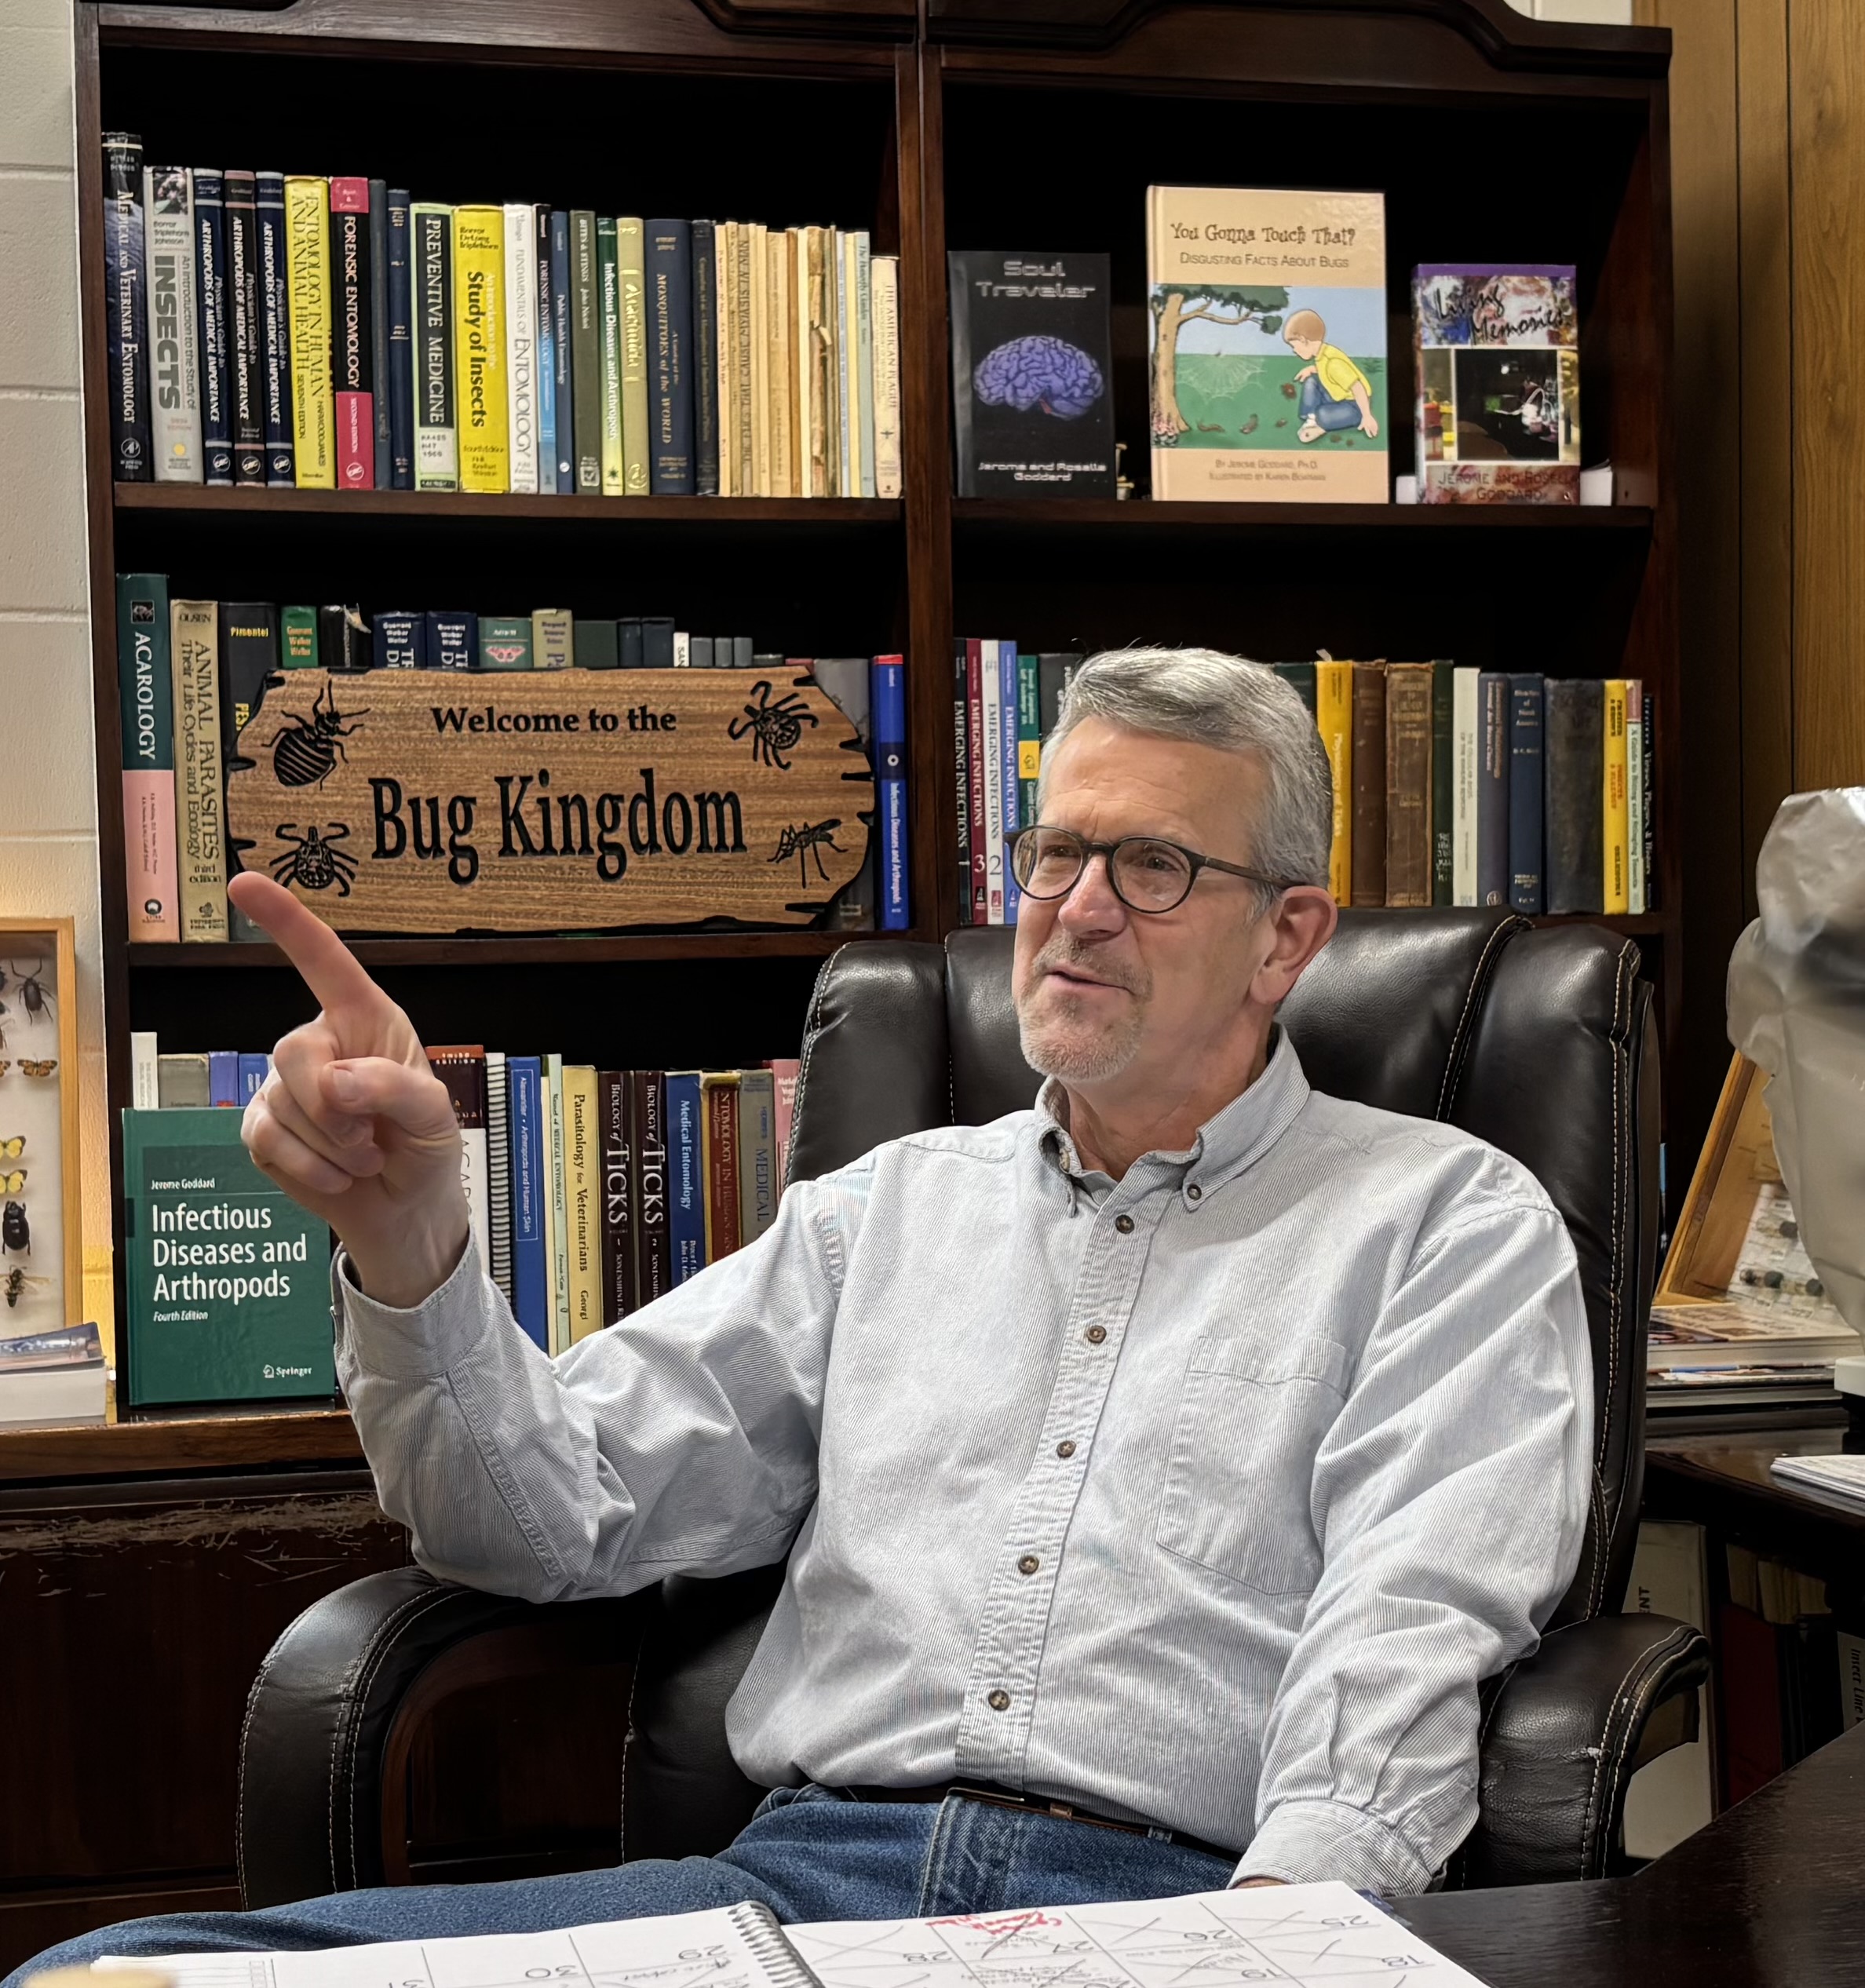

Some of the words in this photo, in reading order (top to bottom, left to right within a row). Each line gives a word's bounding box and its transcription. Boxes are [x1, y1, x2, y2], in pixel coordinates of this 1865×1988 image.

[117, 191, 136, 246] MEDICAL
[292, 197, 307, 232] AND
[1170, 223, 1199, 240] You
[1204, 224, 1256, 245] Gonna
[1262, 225, 1306, 244] Touch
[1311, 225, 1356, 246] That?
[182, 256, 192, 268] An
[203, 219, 214, 291] ARTHROPODS
[233, 216, 245, 288] ARTHROPODS
[264, 221, 276, 294] ARTHROPODS
[293, 237, 309, 303] ANIMAL
[305, 197, 321, 305] ENTOMOLOGY
[344, 216, 360, 283] FORENSIC
[1003, 261, 1067, 278] Soul
[1180, 252, 1242, 267] DISGUSTING
[1244, 254, 1278, 267] FACTS
[1281, 255, 1316, 268] ABOUT
[1319, 256, 1349, 268] BUGS
[425, 219, 443, 328] PREVENTIVE
[514, 250, 528, 319] FUNDAMENTALS
[540, 261, 550, 303] FORENSIC
[604, 263, 616, 313] Infectious
[975, 282, 1096, 298] Traveler
[119, 270, 137, 341] VETERINARY
[183, 271, 194, 333] Introduction
[205, 291, 215, 308] OF
[235, 289, 246, 305] OF
[266, 294, 276, 310] OF
[464, 272, 487, 329] Study
[656, 273, 669, 357] MOSQUITOES
[155, 256, 181, 410] INSECTS
[184, 336, 193, 348] to
[206, 308, 217, 354] MEDICAL
[236, 305, 247, 351] MEDICAL
[267, 310, 279, 356] MEDICAL
[295, 307, 312, 370] HEALTH
[309, 312, 323, 330] IN
[346, 286, 361, 388] ENTOMOLOGY
[469, 332, 487, 353] of
[517, 320, 528, 335] OF
[605, 315, 618, 359] Diseases
[885, 308, 897, 367] AMERICAN
[185, 350, 195, 366] the
[309, 335, 326, 397] HUMAN
[428, 337, 446, 424] MEDICINE
[607, 360, 618, 380] and
[659, 359, 670, 371] of
[122, 341, 140, 424] ENTOMOLOGY
[186, 368, 197, 398] Study
[188, 398, 197, 410] of
[208, 356, 220, 424] IMPORTANCE
[238, 352, 250, 421] IMPORTANCE
[269, 358, 281, 425] IMPORTANCE
[470, 357, 487, 428] Insects
[514, 339, 533, 458] ENTOMOLOGY
[659, 375, 670, 392] the
[606, 381, 620, 440] Arthropods
[660, 397, 672, 444] WORLD
[978, 462, 1027, 472] Jerome
[1029, 462, 1054, 472] and
[1013, 472, 1072, 482] Goddard
[1438, 471, 1490, 485] JEROME
[229, 626, 269, 638] Pimentel
[181, 640, 195, 677] Their
[133, 631, 156, 761] ACAROLOGY
[182, 684, 196, 711] Life
[195, 641, 214, 731] ANIMAL
[181, 715, 199, 761] Cycles
[429, 705, 581, 736] Welcome
[587, 709, 620, 735] to
[627, 705, 679, 735] the
[953, 701, 965, 768] EMERGING
[970, 699, 981, 759] EMERGING
[987, 703, 998, 767] EMERGING
[1004, 706, 1015, 763] EMERGING
[186, 766, 199, 795] and
[199, 740, 220, 859] PARASITES
[890, 782, 902, 818] Infectious
[972, 761, 984, 827] INFECTIONS
[1005, 766, 1017, 829] INFECTIONS
[367, 775, 477, 886] Bug
[494, 768, 750, 885] Kingdom
[955, 771, 968, 848] INFECTIONS
[989, 771, 1000, 839] INFECTIONS
[187, 801, 202, 859] Ecology
[194, 864, 216, 874] third
[973, 854, 986, 874] 3
[989, 855, 1002, 876] 2
[610, 1083, 622, 1130] BIOLOGY
[646, 1085, 657, 1131] BIOLOGY
[680, 1100, 693, 1144] Medical
[573, 1094, 587, 1169] Parasitology
[610, 1131, 622, 1143] of
[646, 1132, 658, 1144] of
[151, 1178, 180, 1190] Jerome
[181, 1176, 216, 1190] Goddard
[606, 1143, 630, 1224] TICKS
[642, 1144, 666, 1225] TICKS
[680, 1146, 695, 1211] Entomology
[723, 1168, 732, 1182] IN
[756, 1148, 770, 1222] MEDICAL
[151, 1202, 272, 1232] Infectious
[577, 1188, 590, 1272] Veterinarians
[152, 1237, 255, 1268] Diseases
[262, 1233, 307, 1263] and
[152, 1268, 291, 1305] Arthropods
[579, 1289, 590, 1321] Georgi
[153, 1310, 180, 1322] Fourth
[181, 1309, 209, 1321] Edition
[276, 1365, 312, 1377] Springer
[1183, 1928, 1234, 1943] 26
[1320, 1914, 1370, 1929] 25
[524, 1962, 577, 1979] 30
[677, 1944, 727, 1961] 29
[903, 1950, 952, 1963] 28
[1053, 1940, 1095, 1955] 27
[1381, 1953, 1425, 1968] 18
[1240, 1967, 1283, 1981] 19
